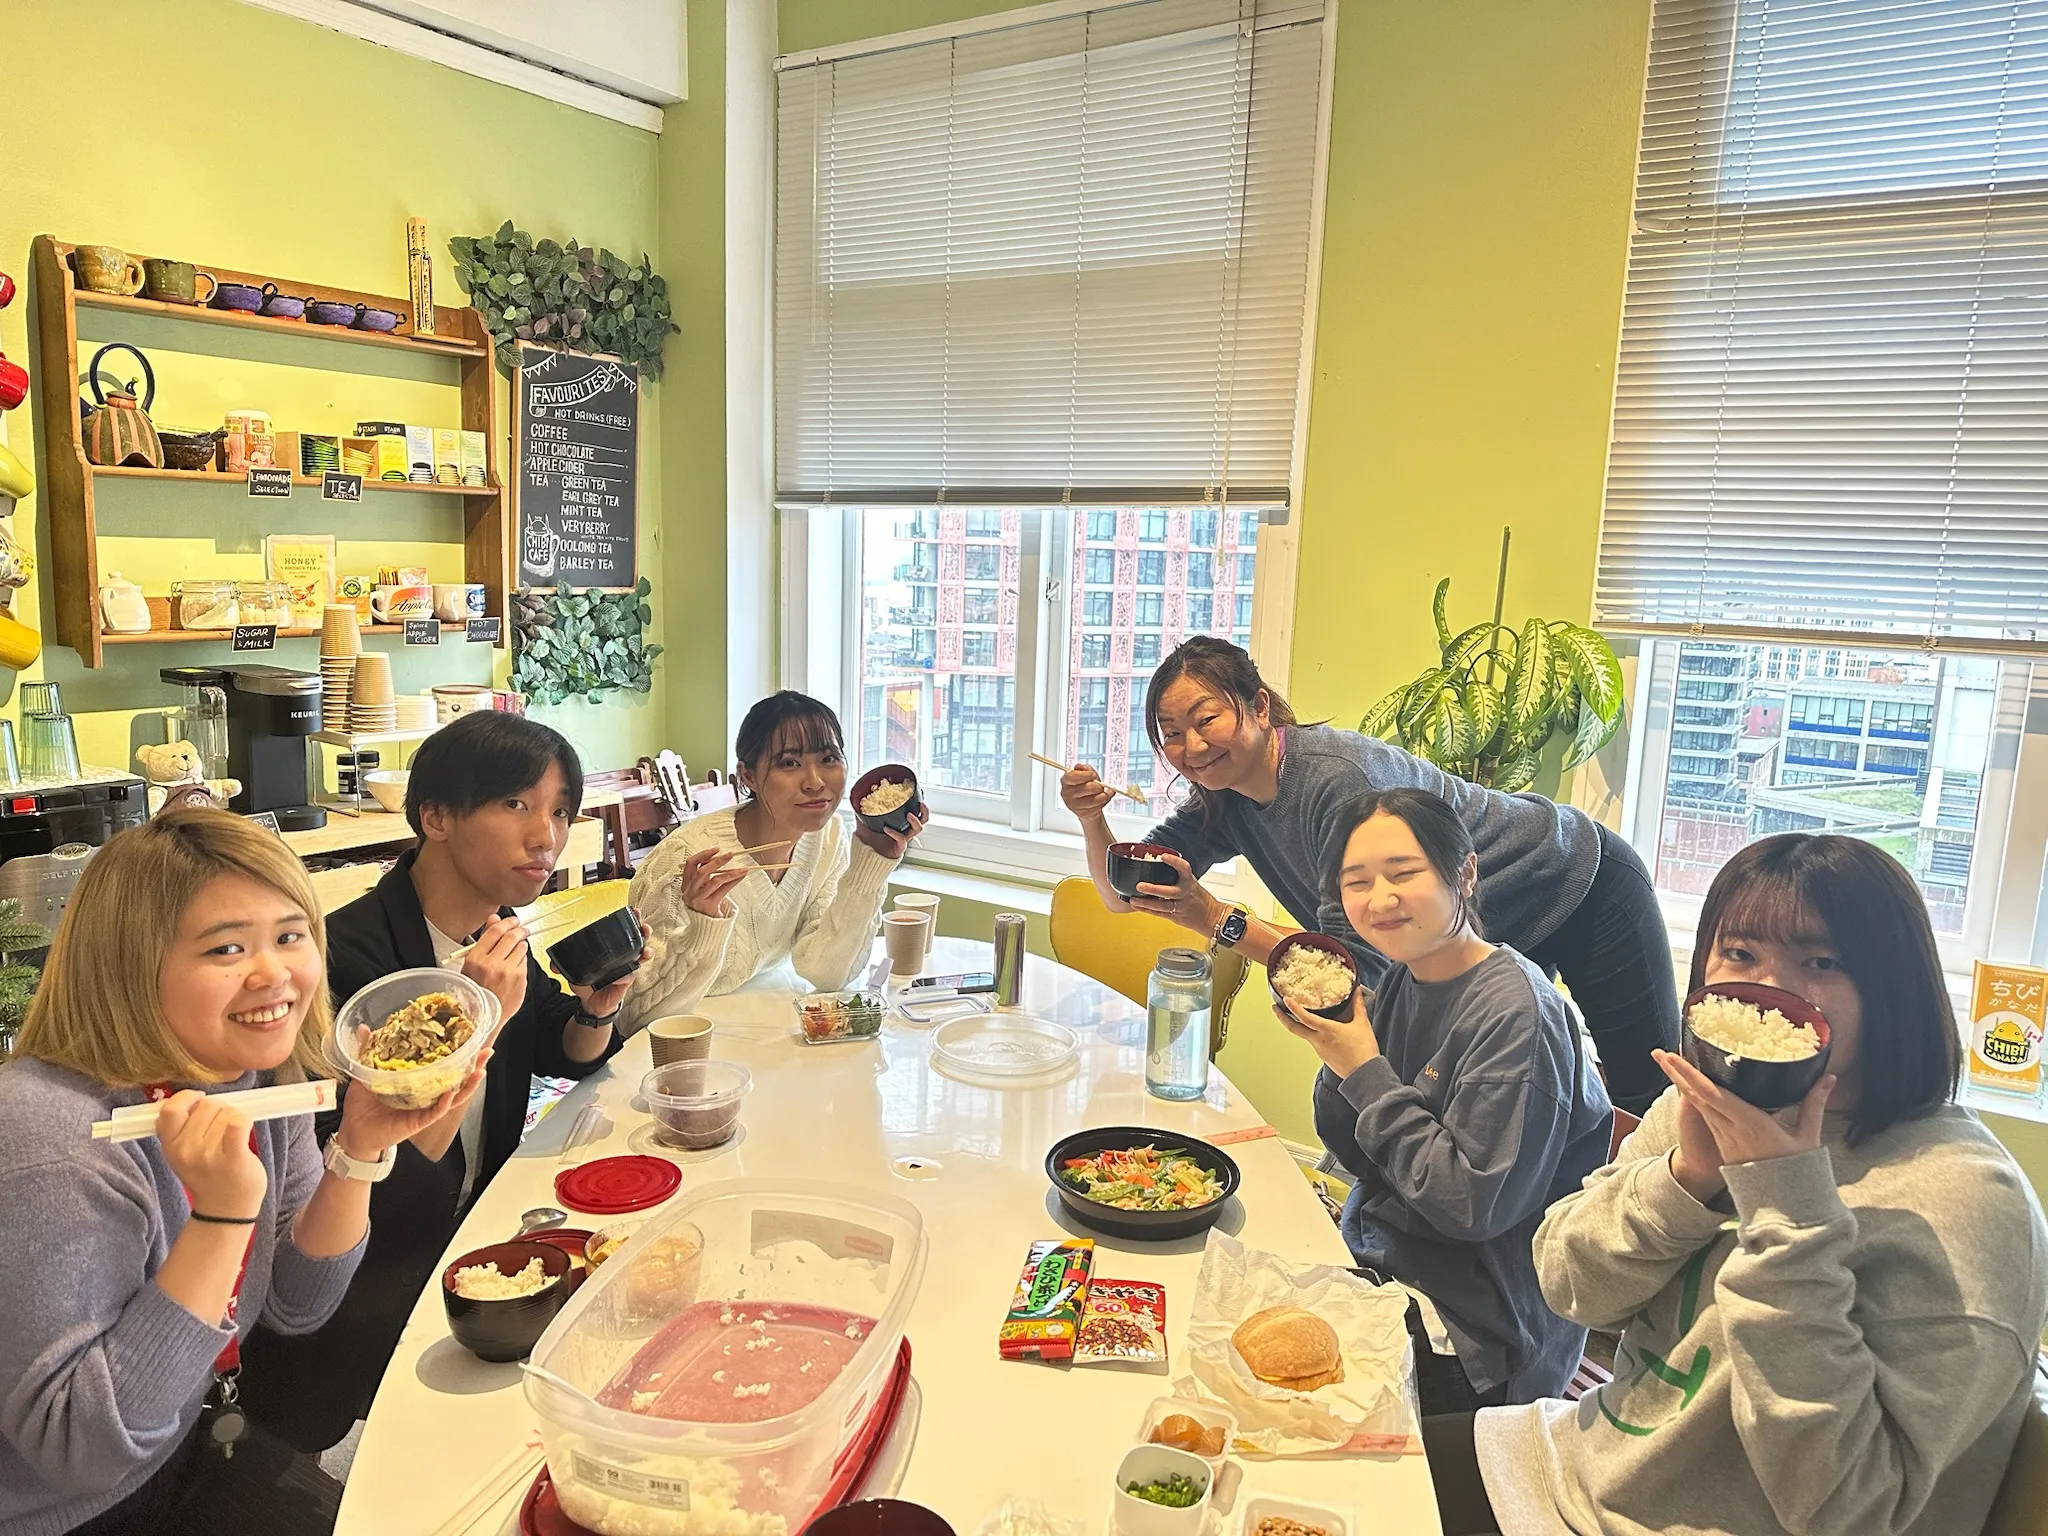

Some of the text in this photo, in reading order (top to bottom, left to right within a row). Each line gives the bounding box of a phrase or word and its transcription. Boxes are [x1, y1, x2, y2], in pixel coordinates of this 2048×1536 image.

[533, 370, 606, 404] FAVOURITES
[554, 408, 572, 419] HOT
[574, 411, 605, 423] DRINKS
[530, 423, 569, 440] COFFEE
[530, 441, 595, 460] HOT CHOCOLATE
[529, 456, 585, 475] APPLE CIDER
[250, 471, 291, 484] LEMONADE
[529, 473, 549, 487] TEA
[561, 475, 607, 491] GREEN TEA
[326, 480, 357, 496] TEA
[562, 490, 620, 508] EARL GREY TEA
[560, 504, 603, 518] MINT TEA
[526, 535, 549, 549] CHIBI
[560, 539, 613, 555] OOLONG TEA
[528, 548, 549, 562] CAFE
[560, 556, 614, 570] BARLEY TEA
[389, 598, 425, 612] Apple
[470, 620, 489, 628] HOT
[236, 627, 269, 639] SUGAR
[415, 636, 437, 644] CIDER
[467, 630, 497, 640] CHOCOLATE
[242, 640, 271, 649] MILK
[1990, 979, 2041, 1000] ちび
[1986, 1038, 2025, 1057] CHIBI
[1985, 1049, 2024, 1063] CANADA
